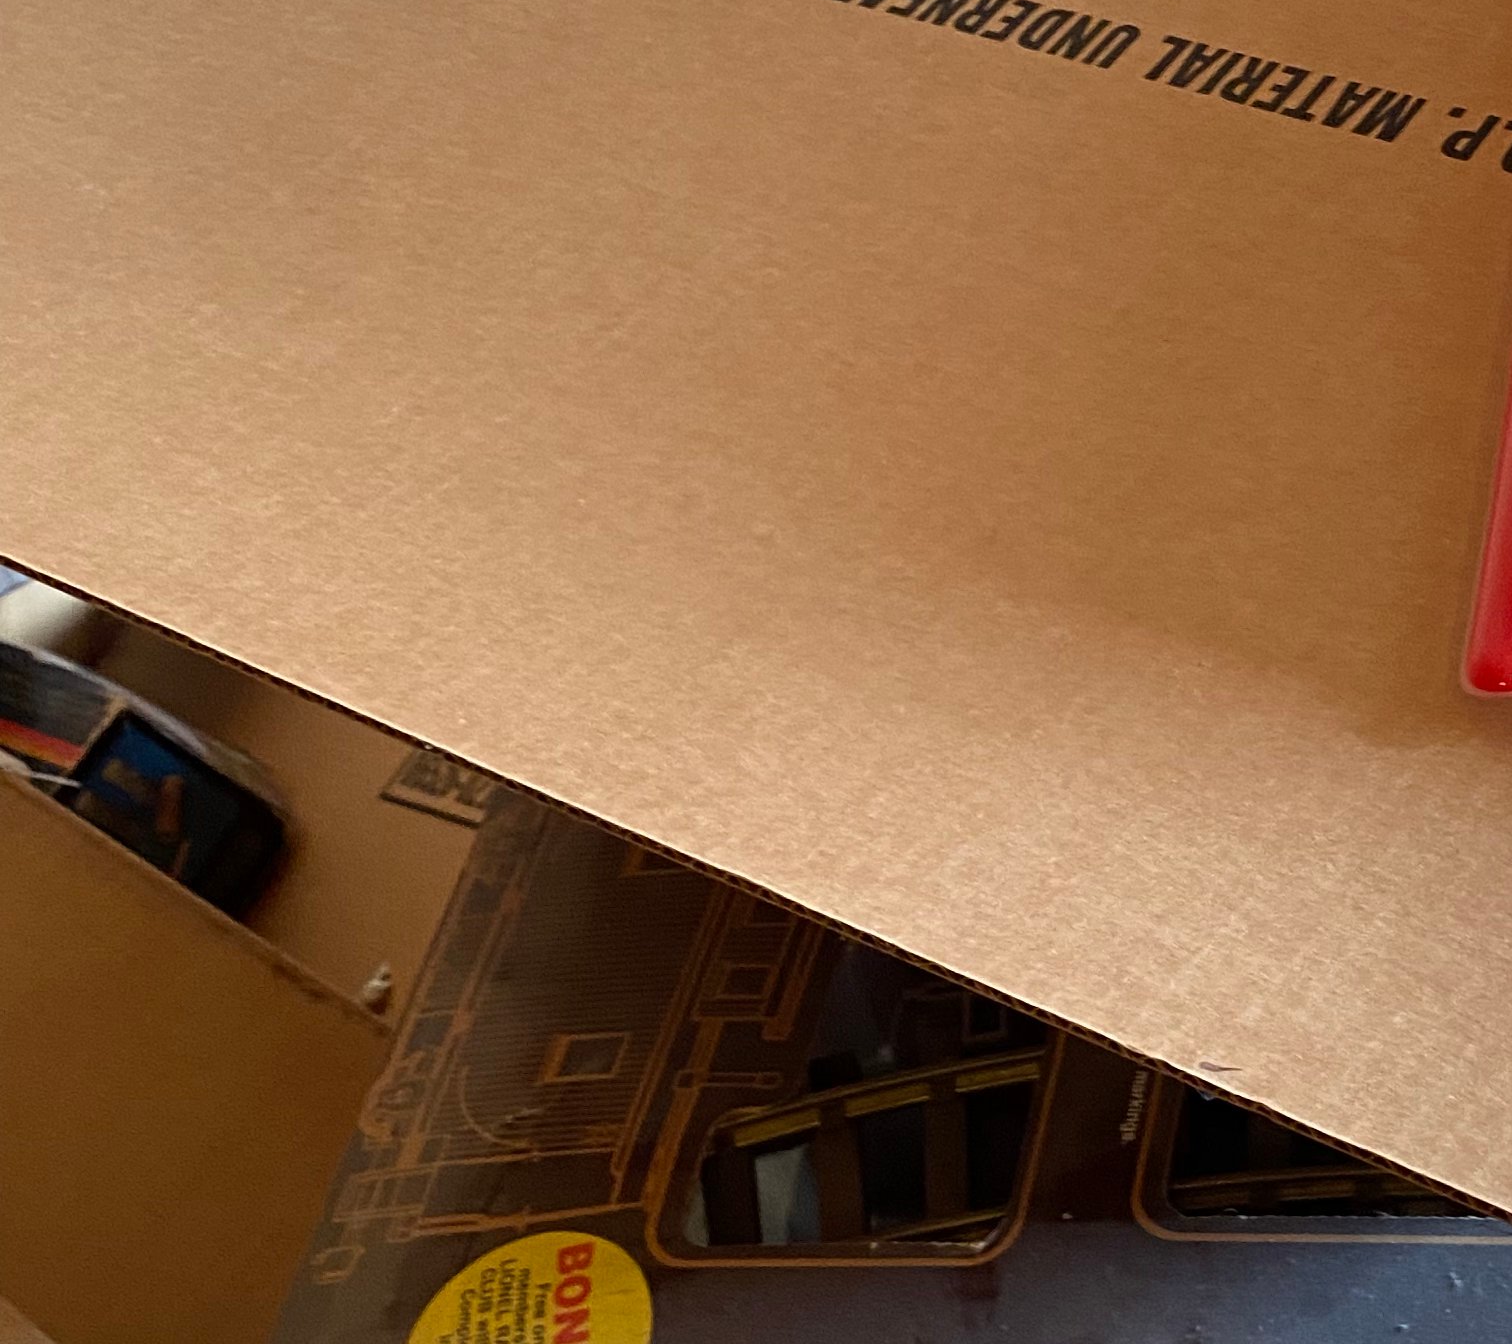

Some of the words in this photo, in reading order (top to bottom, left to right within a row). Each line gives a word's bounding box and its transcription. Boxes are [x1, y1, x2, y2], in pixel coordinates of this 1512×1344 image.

[1143, 34, 1426, 143] MATERIAL
[494, 1258, 518, 1322] LIONEL
[534, 1282, 551, 1318] Free
